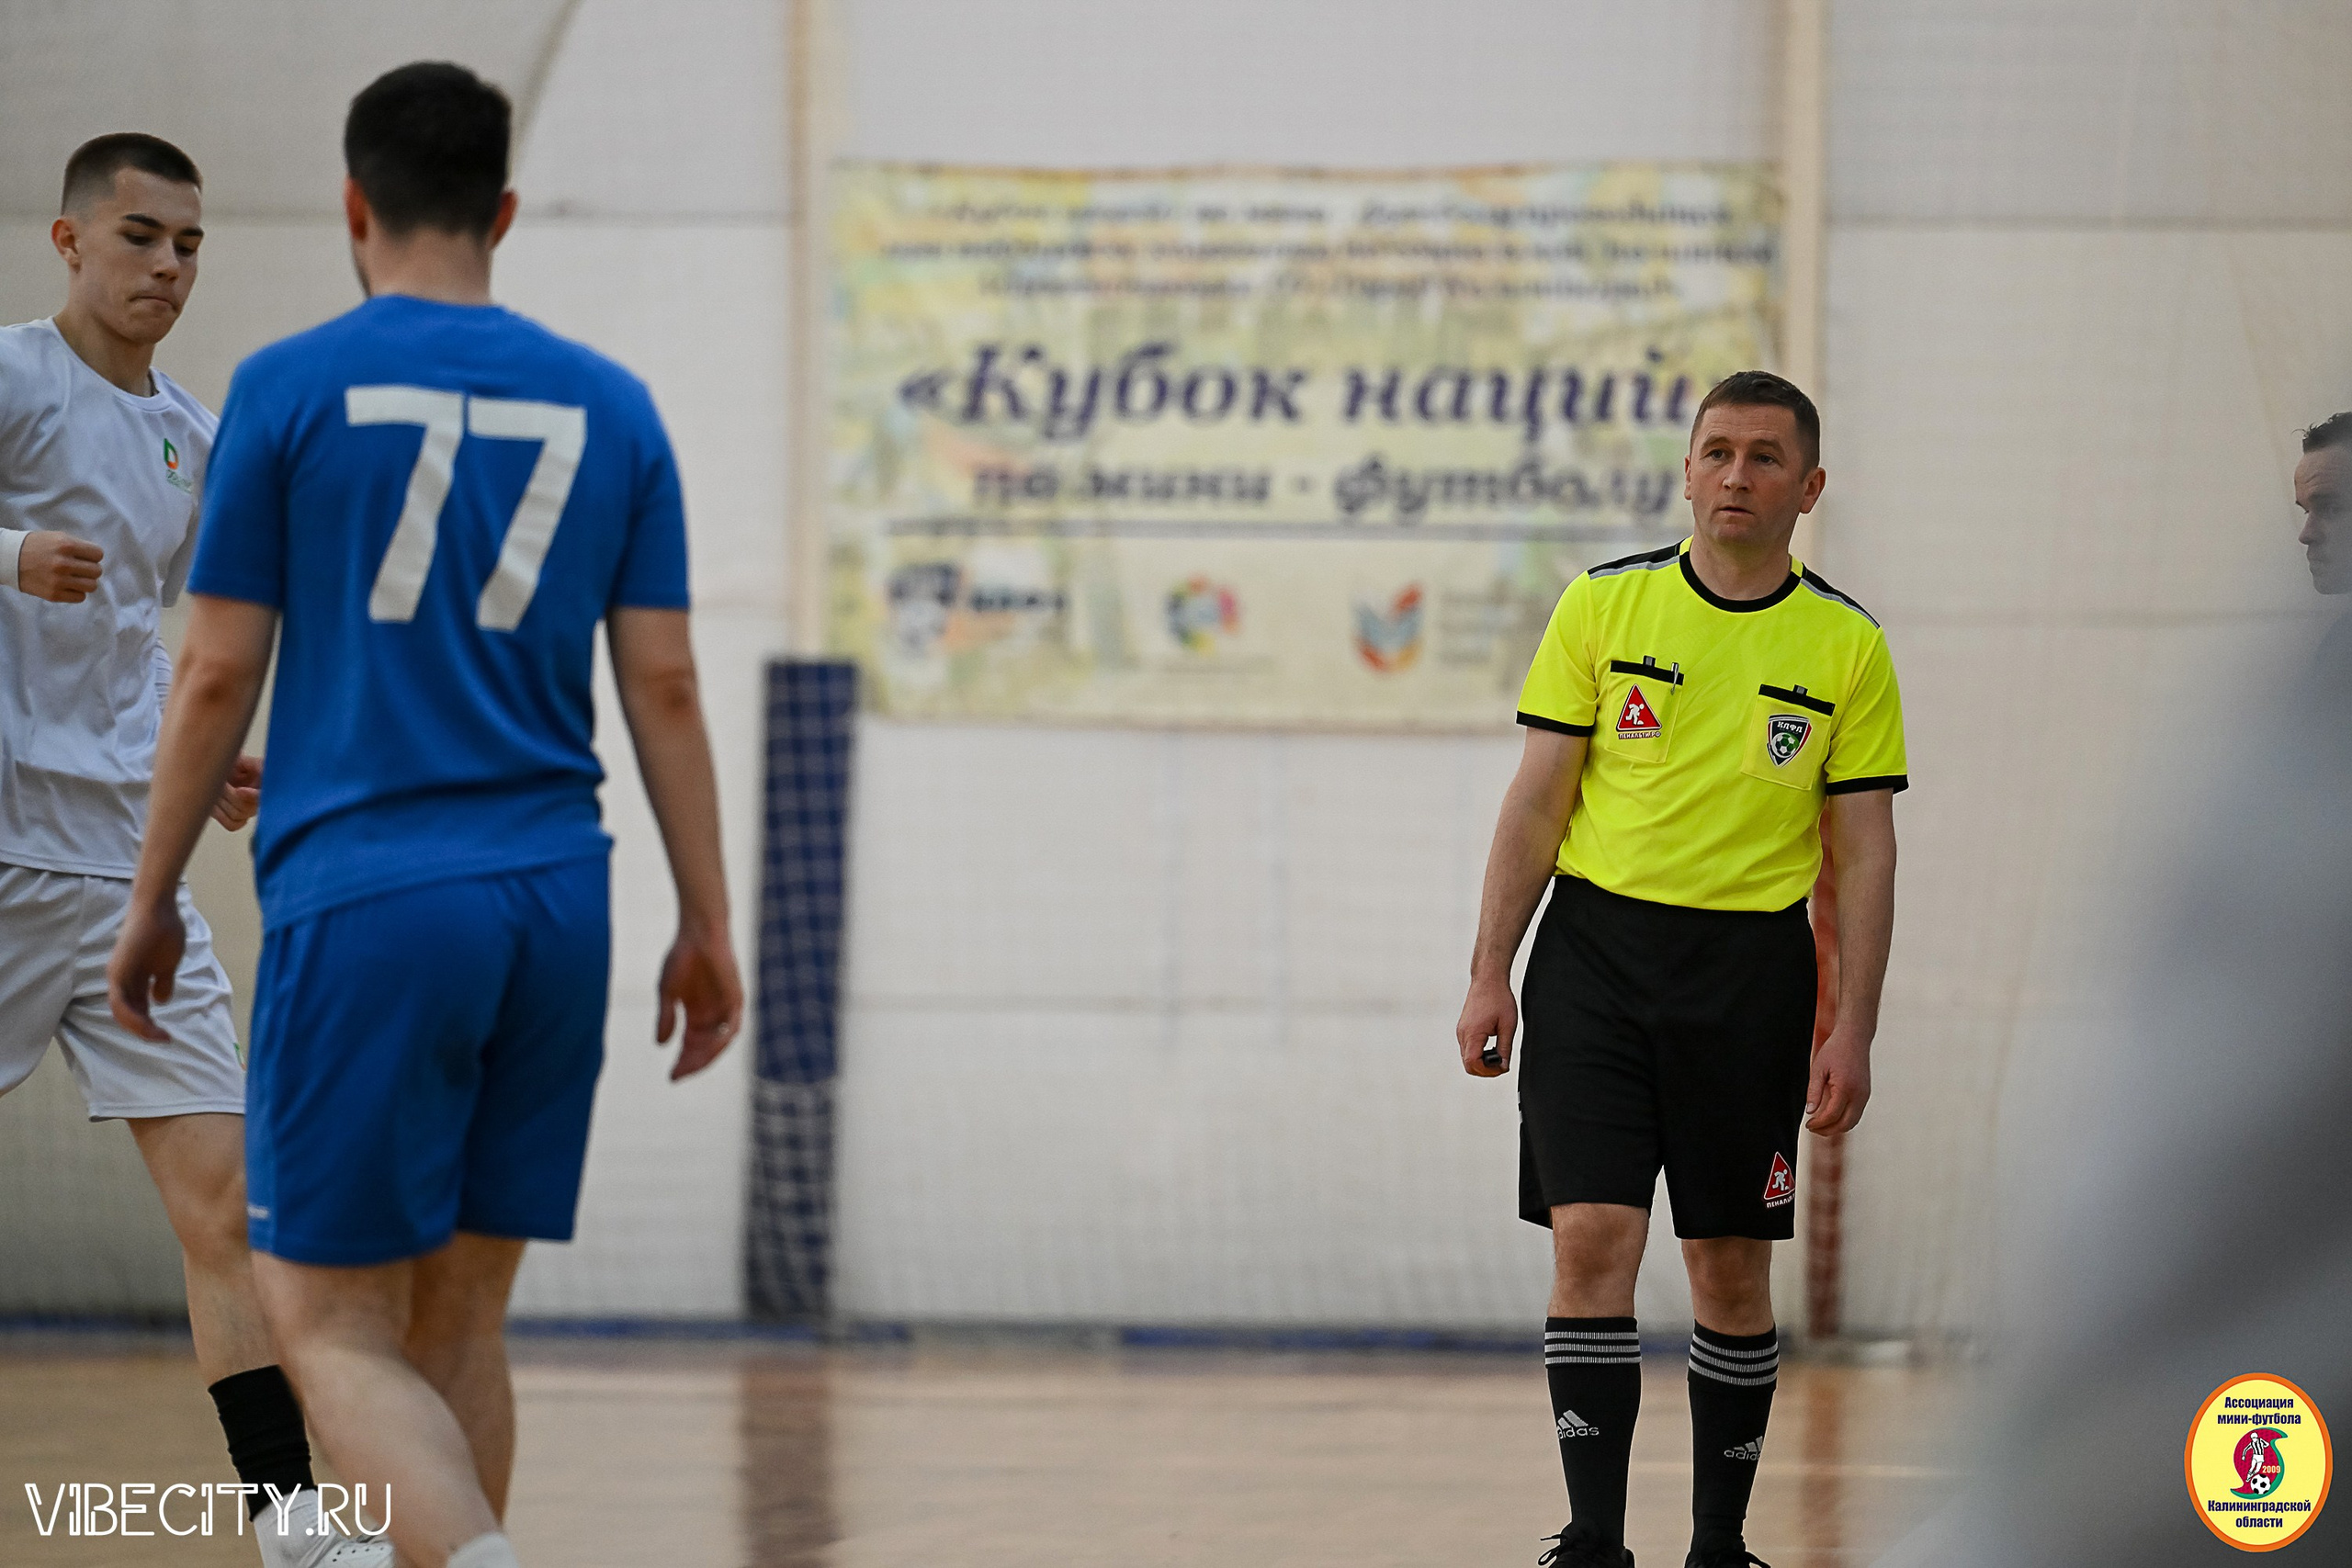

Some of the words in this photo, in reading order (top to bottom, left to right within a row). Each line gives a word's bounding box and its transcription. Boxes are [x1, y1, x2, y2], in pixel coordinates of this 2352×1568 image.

[899, 339, 1308, 445] «Кубок
[1341, 345, 1691, 443] наций
[345, 384, 589, 634] 77
[1777, 721, 1804, 733] КЛФЛ
[1557, 1426, 1599, 1439] didas
[1724, 1450, 1761, 1461] adid
